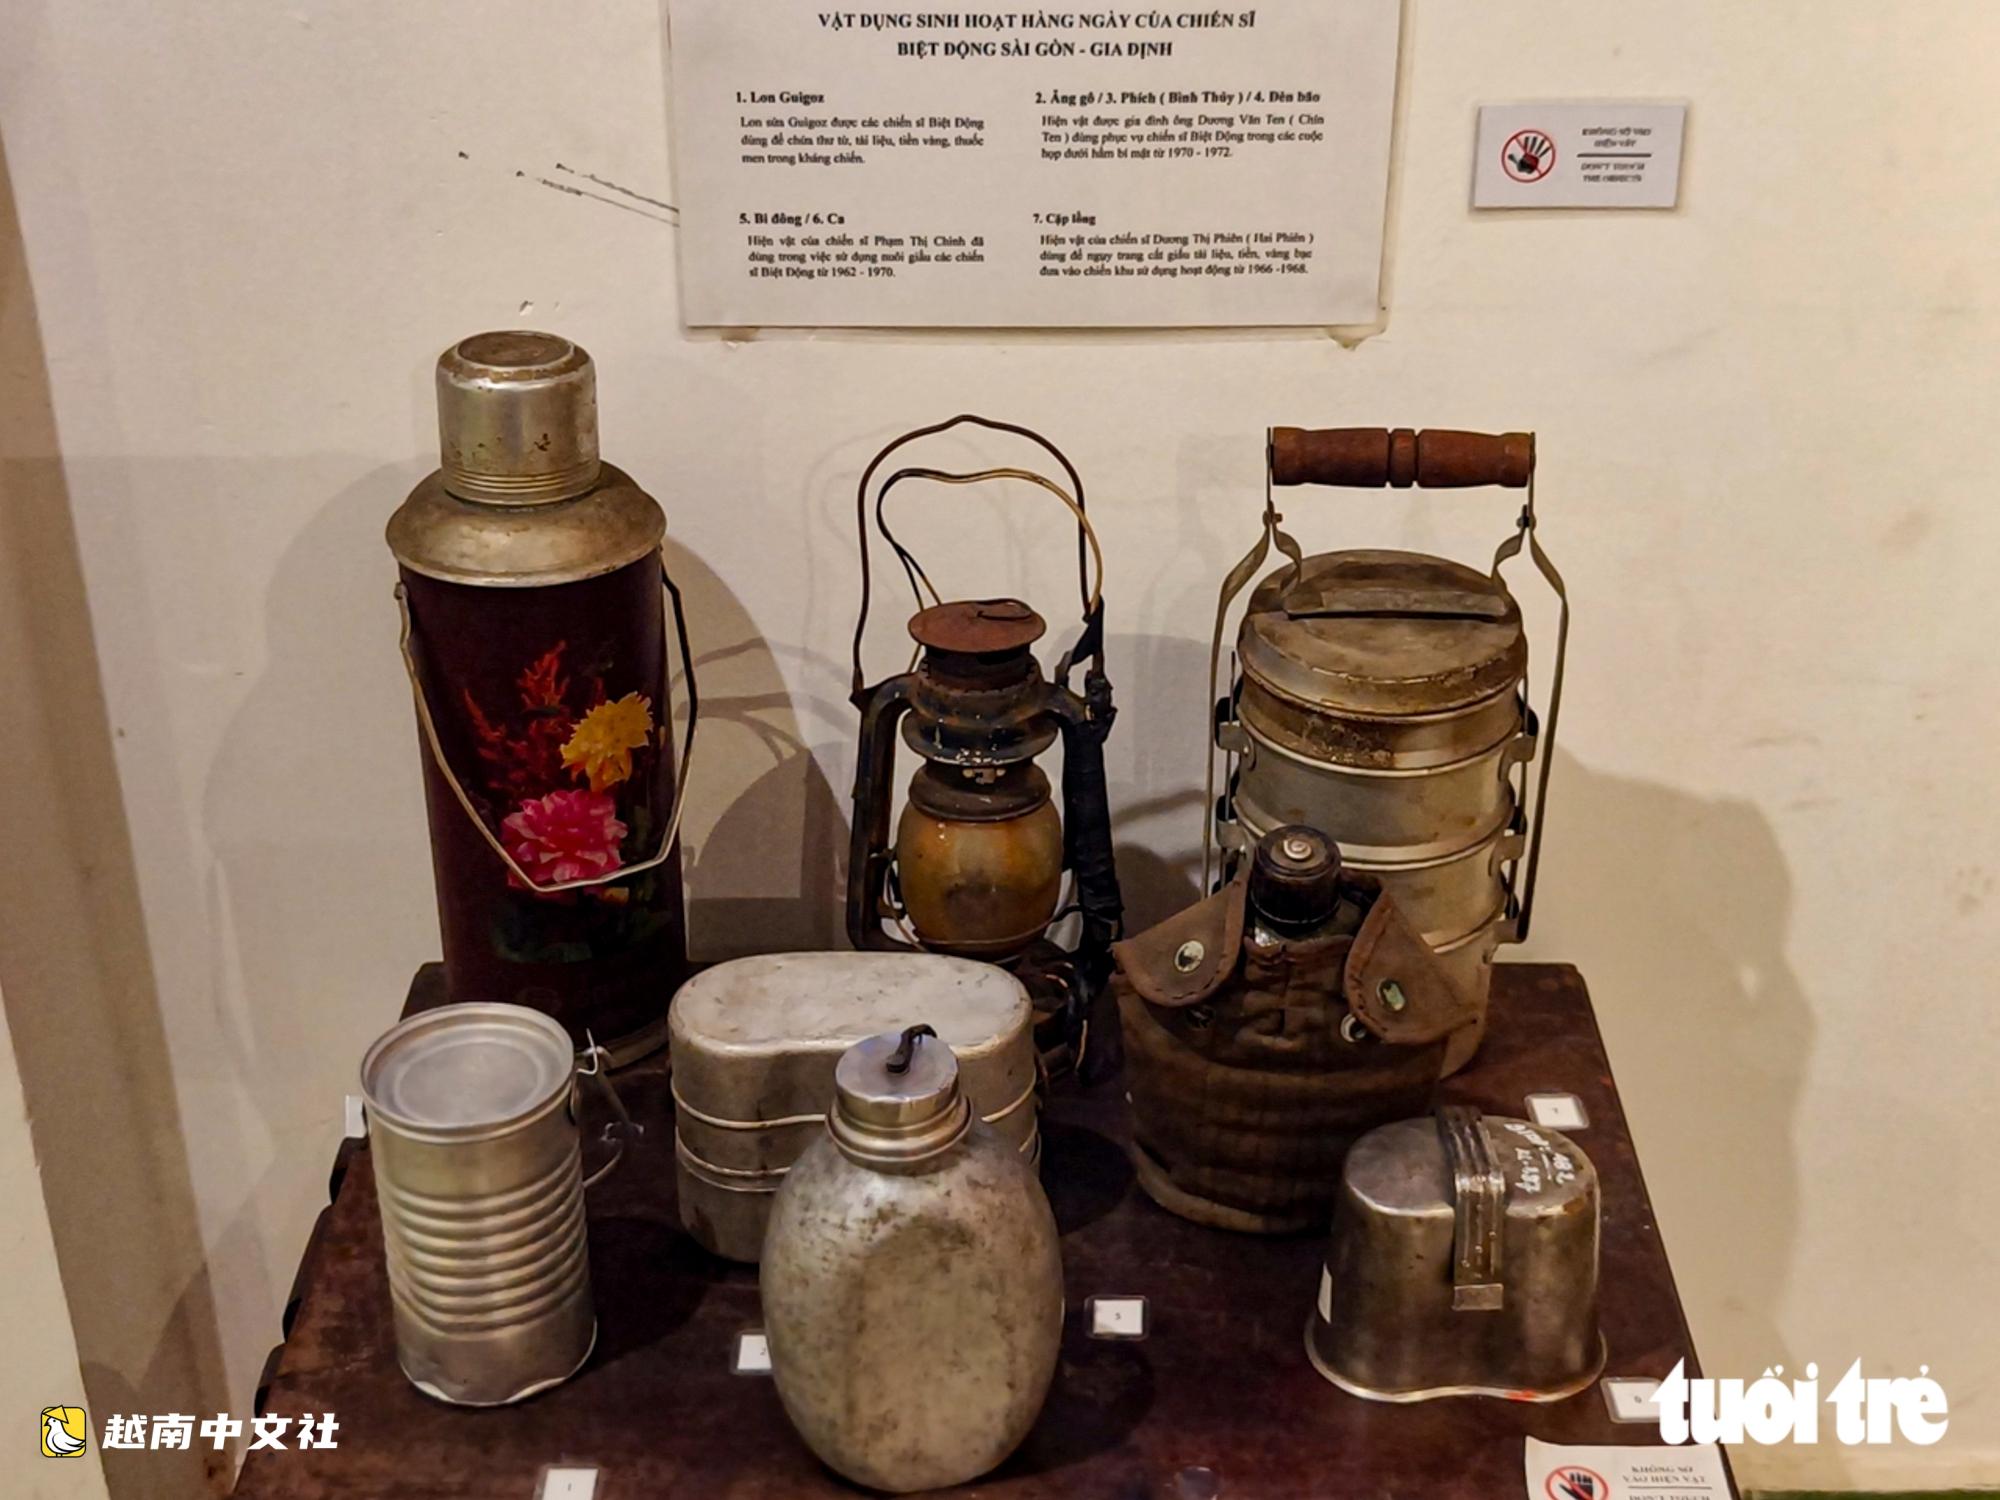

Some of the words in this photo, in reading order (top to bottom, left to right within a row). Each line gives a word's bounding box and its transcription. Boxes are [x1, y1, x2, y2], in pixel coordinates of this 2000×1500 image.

[817, 11, 856, 31] VẬT
[860, 13, 912, 31] DỤNG
[916, 13, 959, 28] SINH
[964, 13, 1017, 32] HOẠT
[1021, 10, 1074, 28] HÀNG
[1078, 10, 1131, 28] NGÀY
[1134, 10, 1172, 28] CỦA
[1176, 9, 1234, 28] CHIẾN
[1238, 10, 1255, 28] SĨ
[897, 40, 940, 59] BIỆT
[943, 40, 996, 60] ĐỘNG
[1000, 38, 1030, 56] SÀI
[1034, 38, 1075, 56] GÒN
[1089, 42, 1122, 56] GIA
[1127, 41, 1172, 60] ĐỊNH
[736, 91, 747, 103] 1.
[750, 90, 776, 103] Lon
[778, 91, 824, 106] Guigoz
[1035, 91, 1047, 104] 2.
[1104, 91, 1117, 104] 3.
[1120, 91, 1156, 104] Phích
[1168, 91, 1198, 104] Bình
[1200, 90, 1235, 106] Thủy
[1253, 90, 1265, 102] 4.
[1268, 90, 1294, 103] Đèn
[1296, 90, 1321, 103] bão
[740, 116, 763, 128] Lon
[787, 116, 828, 130] Guigoz
[830, 116, 858, 129] được
[860, 116, 880, 128] các
[882, 114, 912, 128] chiến
[915, 116, 925, 128] sĩ
[928, 116, 951, 130] Biệt
[954, 116, 984, 131] Động
[1041, 114, 1068, 128] Hiện
[1071, 114, 1089, 128] vật
[1092, 115, 1120, 128] được
[1144, 114, 1169, 126] đình
[1172, 114, 1194, 128] ông
[1197, 114, 1234, 128] Dương
[1238, 113, 1261, 125] Văn
[1265, 113, 1286, 125] Ten
[1298, 113, 1325, 125] Chín
[740, 134, 768, 148] dùng
[770, 132, 784, 146] để
[816, 134, 835, 146] thư
[954, 132, 984, 146] thuốc
[1041, 130, 1062, 143] Ten
[1071, 131, 1099, 145] dùng
[1100, 131, 1128, 146] phục
[1130, 134, 1144, 144] vụ
[1146, 128, 1176, 142] chiến
[1177, 130, 1188, 142] sĩ
[1189, 130, 1212, 143] Biệt
[1214, 130, 1245, 144] Động
[1246, 132, 1275, 144] trong
[1276, 130, 1296, 141] các
[741, 154, 766, 163] men
[766, 154, 796, 166] trong
[797, 151, 832, 166] kháng
[1040, 147, 1062, 161] họp
[1116, 147, 1128, 159] bí
[1130, 147, 1151, 160] mật
[1152, 147, 1166, 158] từ
[1168, 146, 1194, 158] 1970
[738, 212, 751, 224] 5.
[753, 212, 768, 224] Bi
[770, 212, 802, 227] đông
[812, 212, 824, 224] 6.
[826, 212, 845, 224] Ca
[1032, 212, 1043, 224] 7.
[1045, 212, 1070, 226] Cặp
[747, 234, 774, 248] Hiện
[778, 235, 796, 248] vật
[800, 235, 820, 246] của
[824, 232, 854, 246] chiến
[858, 235, 869, 246] sĩ
[874, 235, 904, 248] Phạm
[909, 235, 928, 250] Thị
[970, 236, 984, 250] đã
[1040, 234, 1066, 247] Hiện
[1068, 234, 1085, 249] vật
[1086, 235, 1107, 245] của
[1108, 231, 1138, 245] chiến
[1140, 233, 1151, 245] sĩ
[1152, 233, 1189, 248] Dương
[1192, 233, 1210, 245] Thị
[1213, 232, 1244, 244] Phiên
[1275, 232, 1306, 243] Phiên
[747, 250, 775, 264] dùng
[777, 252, 807, 264] trong
[809, 250, 832, 264] việc
[850, 250, 878, 264] dụng
[933, 251, 952, 262] các
[954, 248, 984, 262] chiến
[1039, 249, 1066, 263] dùng
[1069, 247, 1083, 261] để
[1116, 251, 1144, 263] trang
[748, 266, 759, 277] sĩ
[760, 266, 783, 279] Biệt
[785, 266, 815, 280] Động
[816, 266, 829, 277] từ
[831, 266, 856, 277] 1962
[867, 266, 897, 277] 1970.
[1061, 265, 1082, 276] vào
[1082, 263, 1112, 276] chiến
[1114, 264, 1134, 276] khu
[1150, 265, 1178, 278] dụng
[1180, 264, 1203, 276] hoạt
[1204, 263, 1231, 277] động
[1233, 264, 1245, 274] từ
[1248, 263, 1274, 274] 1966
